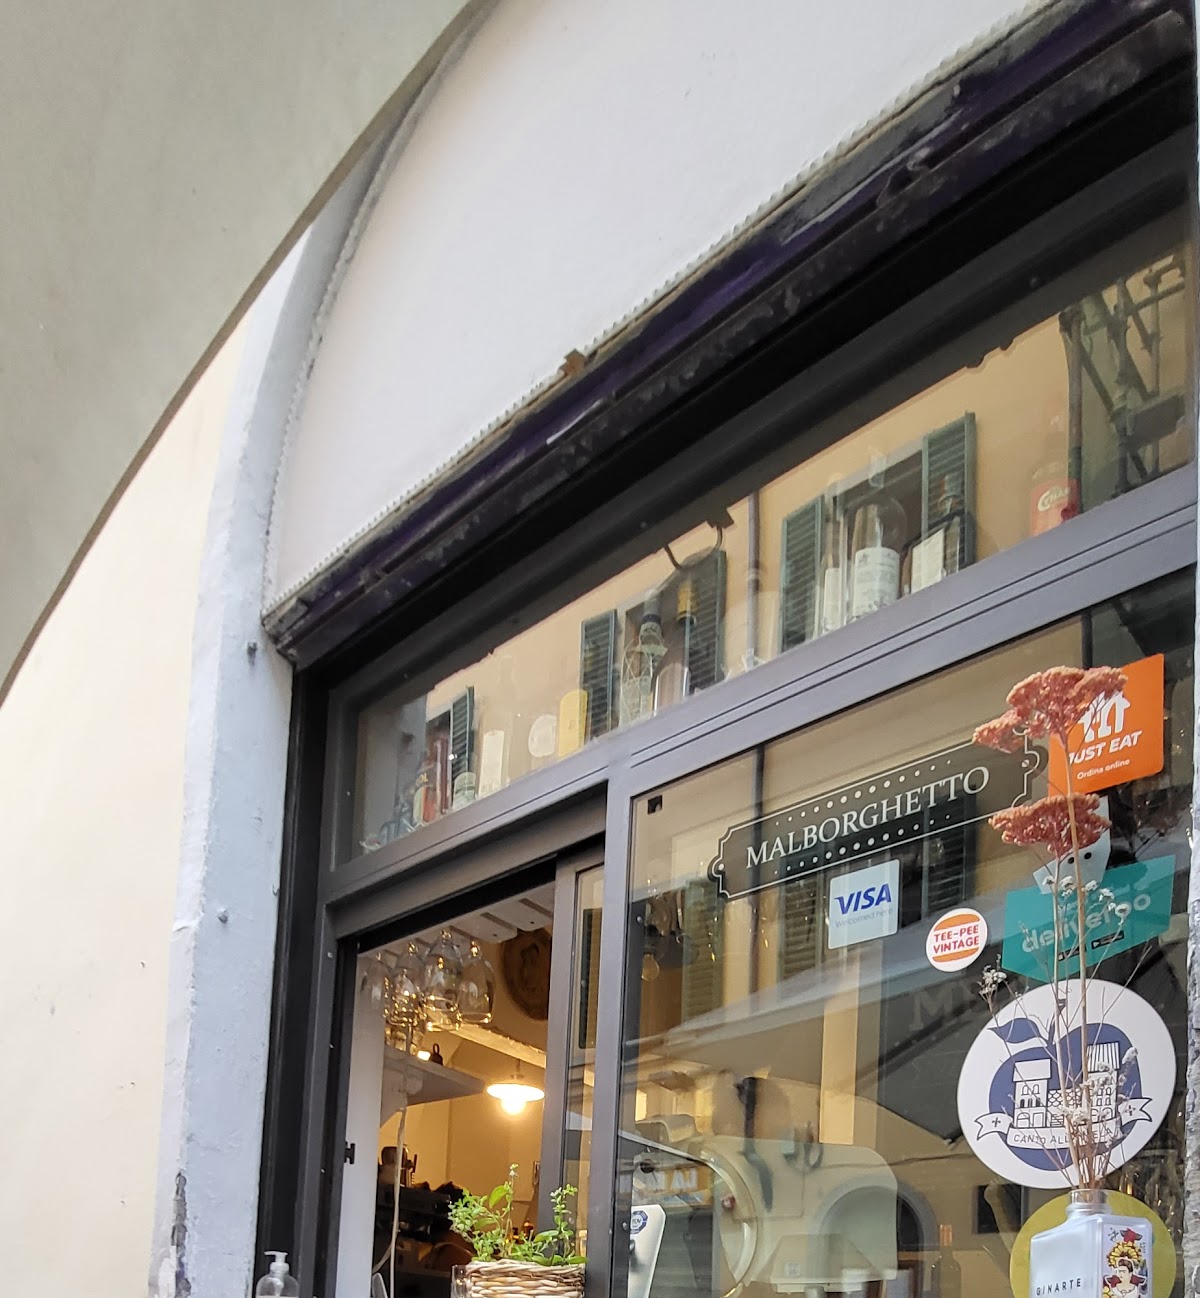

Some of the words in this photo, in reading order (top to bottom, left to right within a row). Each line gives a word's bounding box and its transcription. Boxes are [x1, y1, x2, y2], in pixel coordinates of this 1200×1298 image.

[1067, 742, 1107, 765] JUST
[1108, 730, 1143, 753] EAT
[1077, 765, 1104, 780] Ordina
[1105, 759, 1130, 772] online
[746, 765, 990, 869] MALBORGHETTO
[834, 883, 892, 915] VISA
[933, 924, 979, 943] TEE-PEE
[1022, 893, 1151, 953] deiveroo
[932, 936, 979, 954] VINTAGE
[1036, 1278, 1081, 1296] GINARTE
